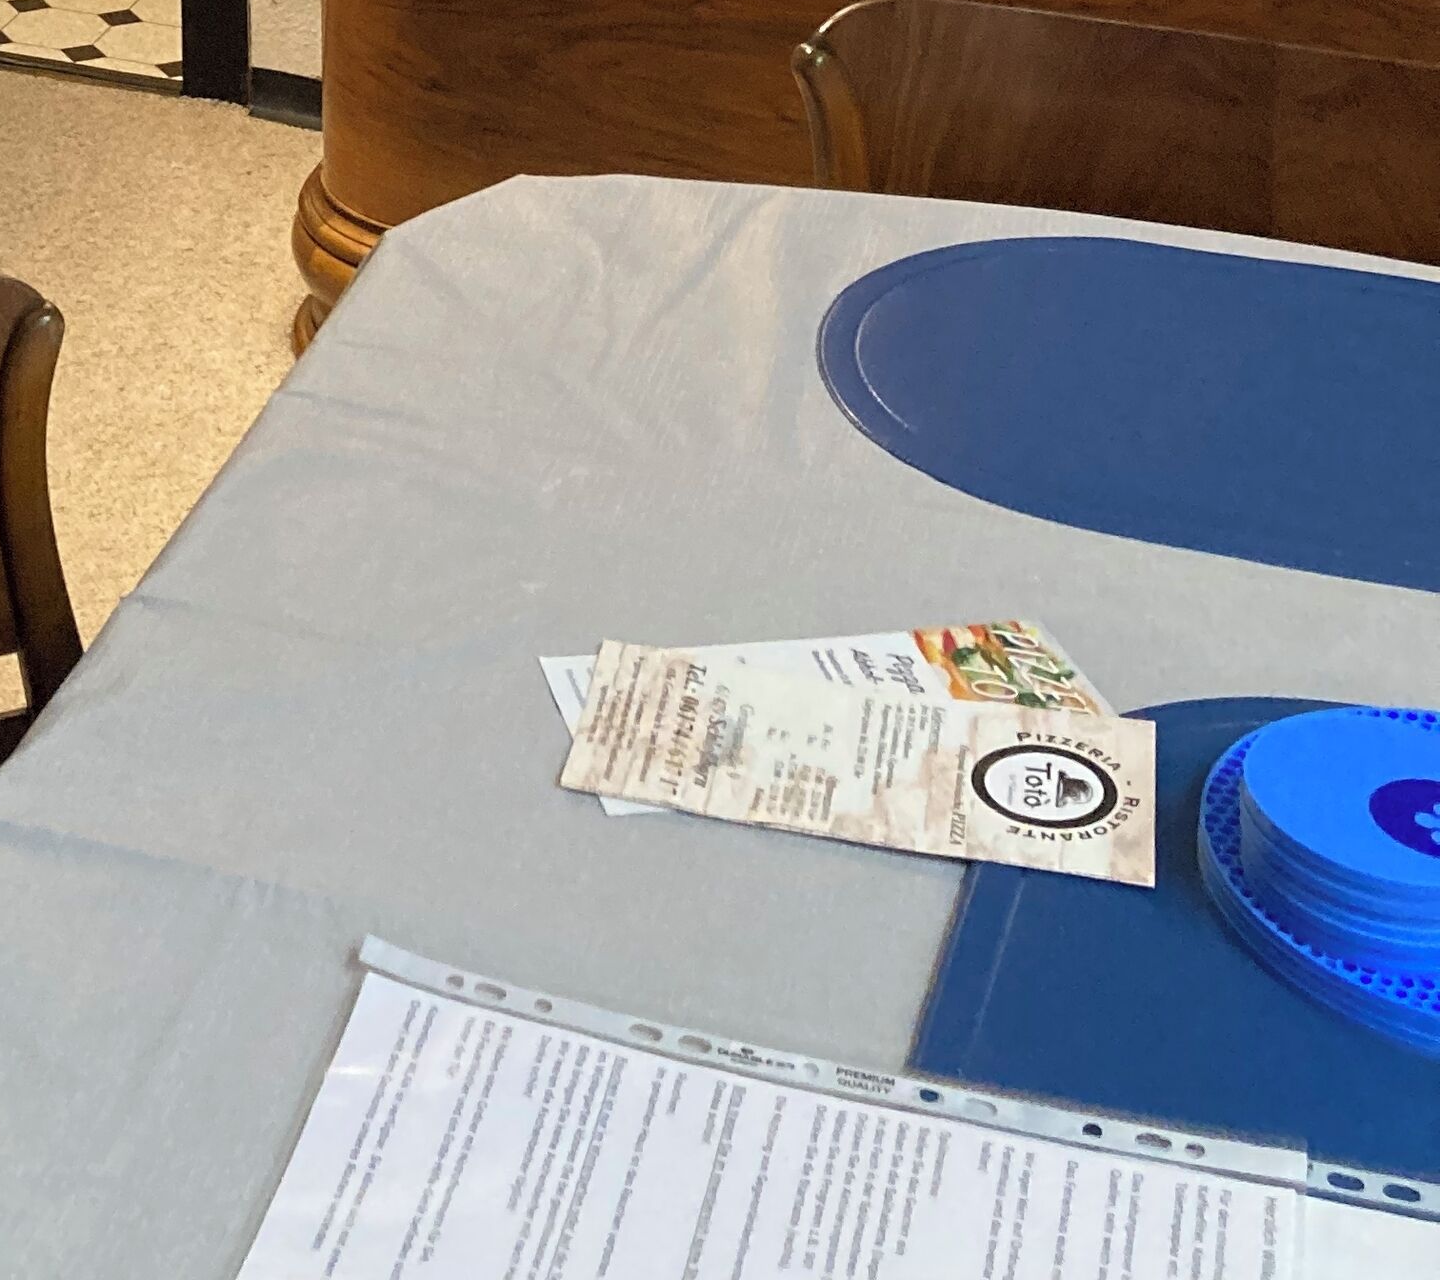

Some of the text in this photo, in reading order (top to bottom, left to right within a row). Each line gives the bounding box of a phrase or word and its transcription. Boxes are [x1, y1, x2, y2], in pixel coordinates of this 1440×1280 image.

[1016, 731, 1122, 772] PIZZERIA
[1023, 762, 1053, 809] Totò
[949, 811, 966, 845] PIZZA
[1006, 796, 1140, 841] RISTORANTE
[835, 1066, 896, 1087] PREMIUM
[837, 1076, 892, 1095] QUALITY
